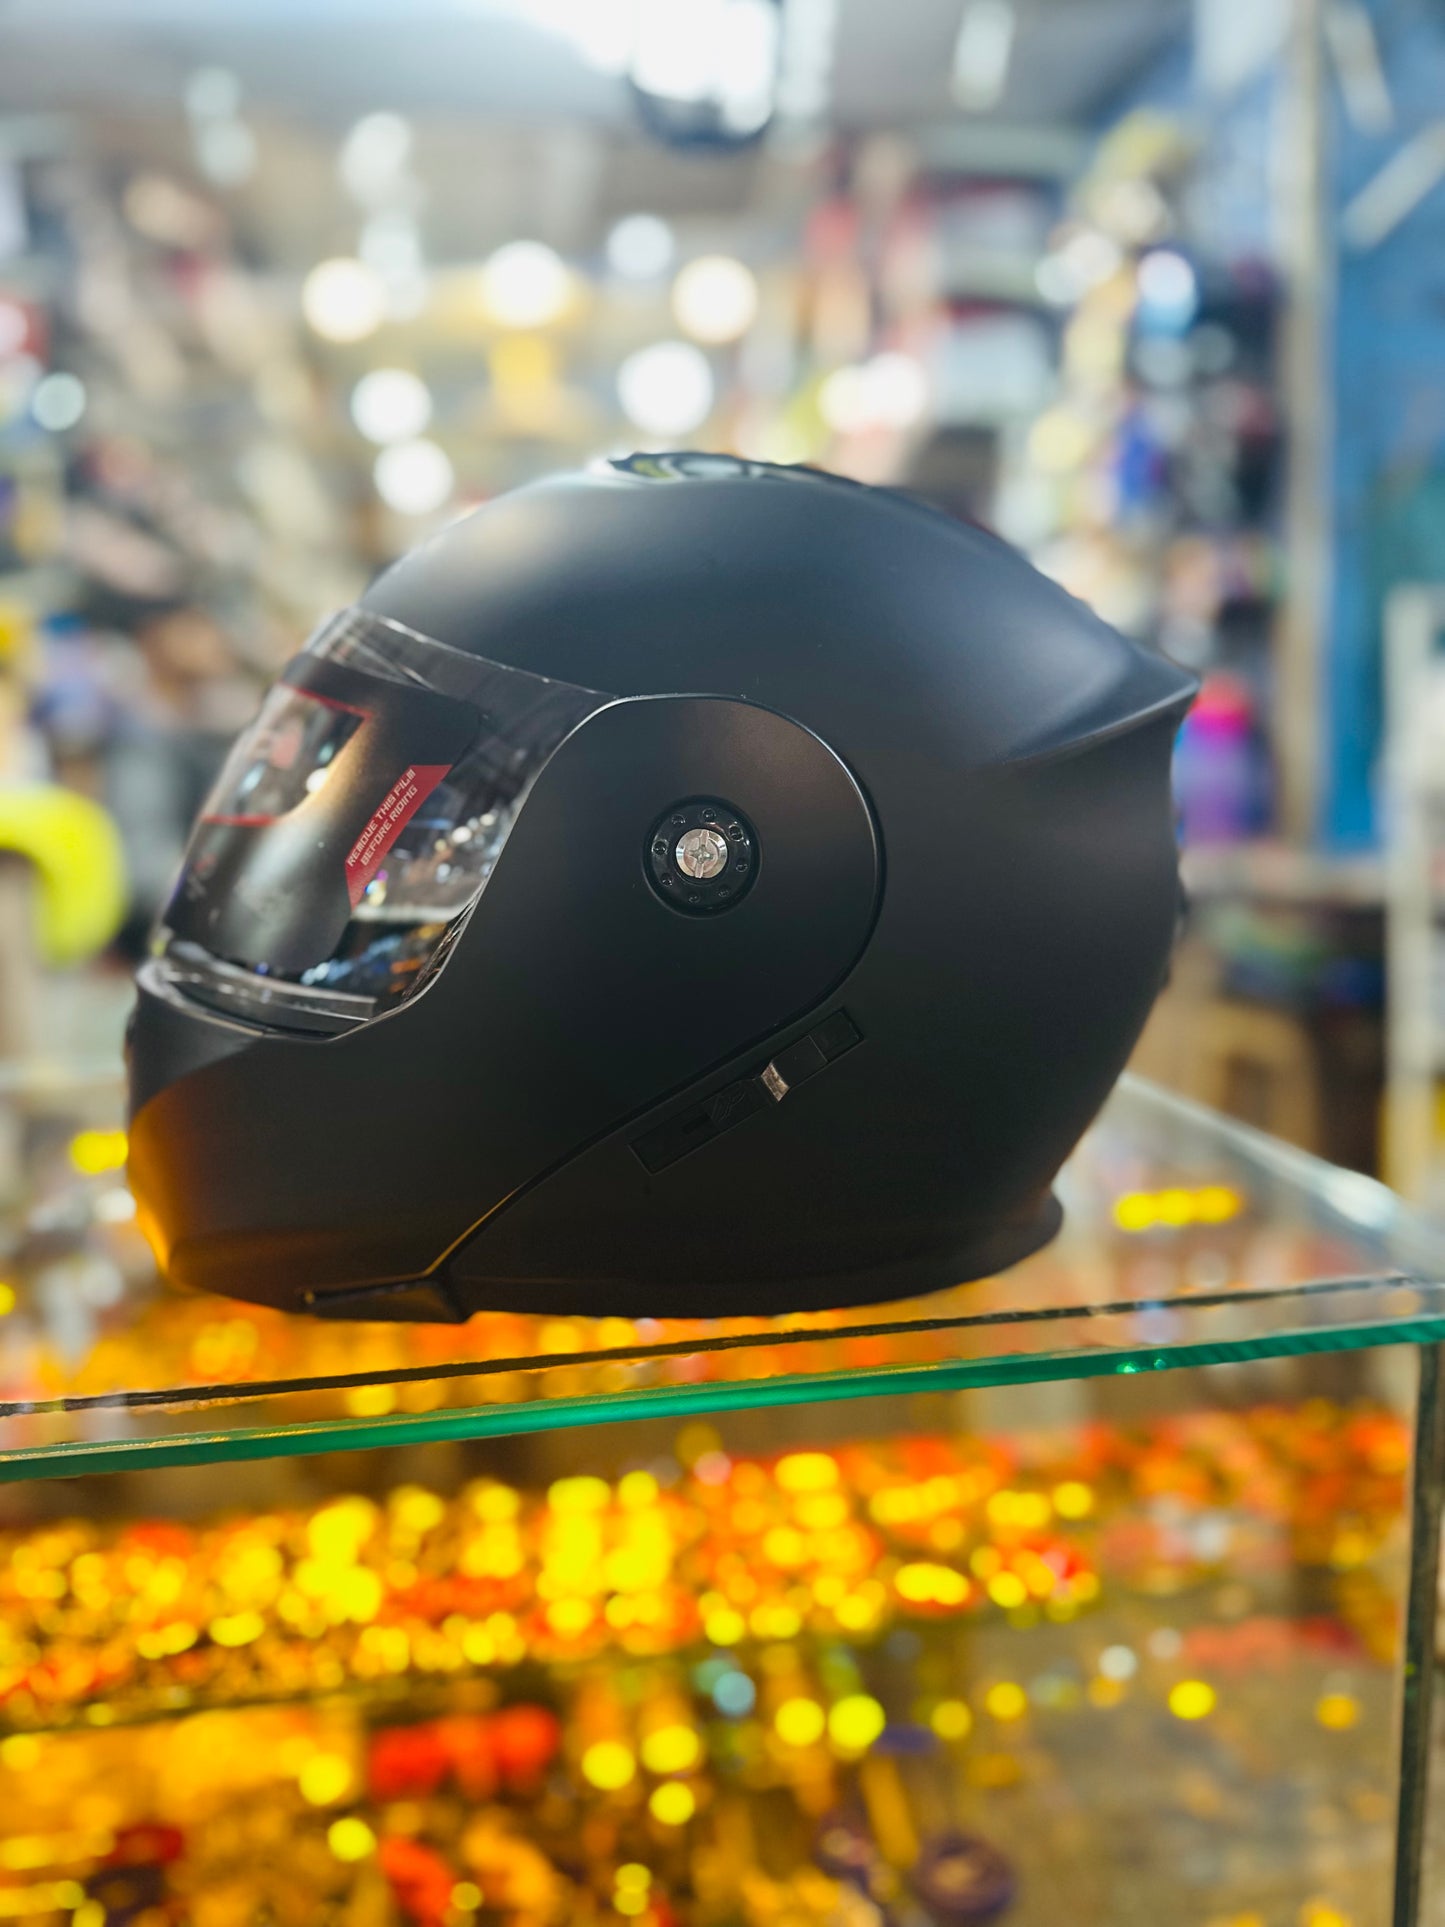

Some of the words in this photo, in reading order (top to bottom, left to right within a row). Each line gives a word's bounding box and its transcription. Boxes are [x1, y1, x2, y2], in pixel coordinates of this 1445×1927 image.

[347, 820, 378, 867] REMOVE
[376, 794, 396, 820] THIS
[394, 768, 417, 796] FILM
[360, 819, 393, 866] BEFORE
[389, 784, 418, 822] RIDING
